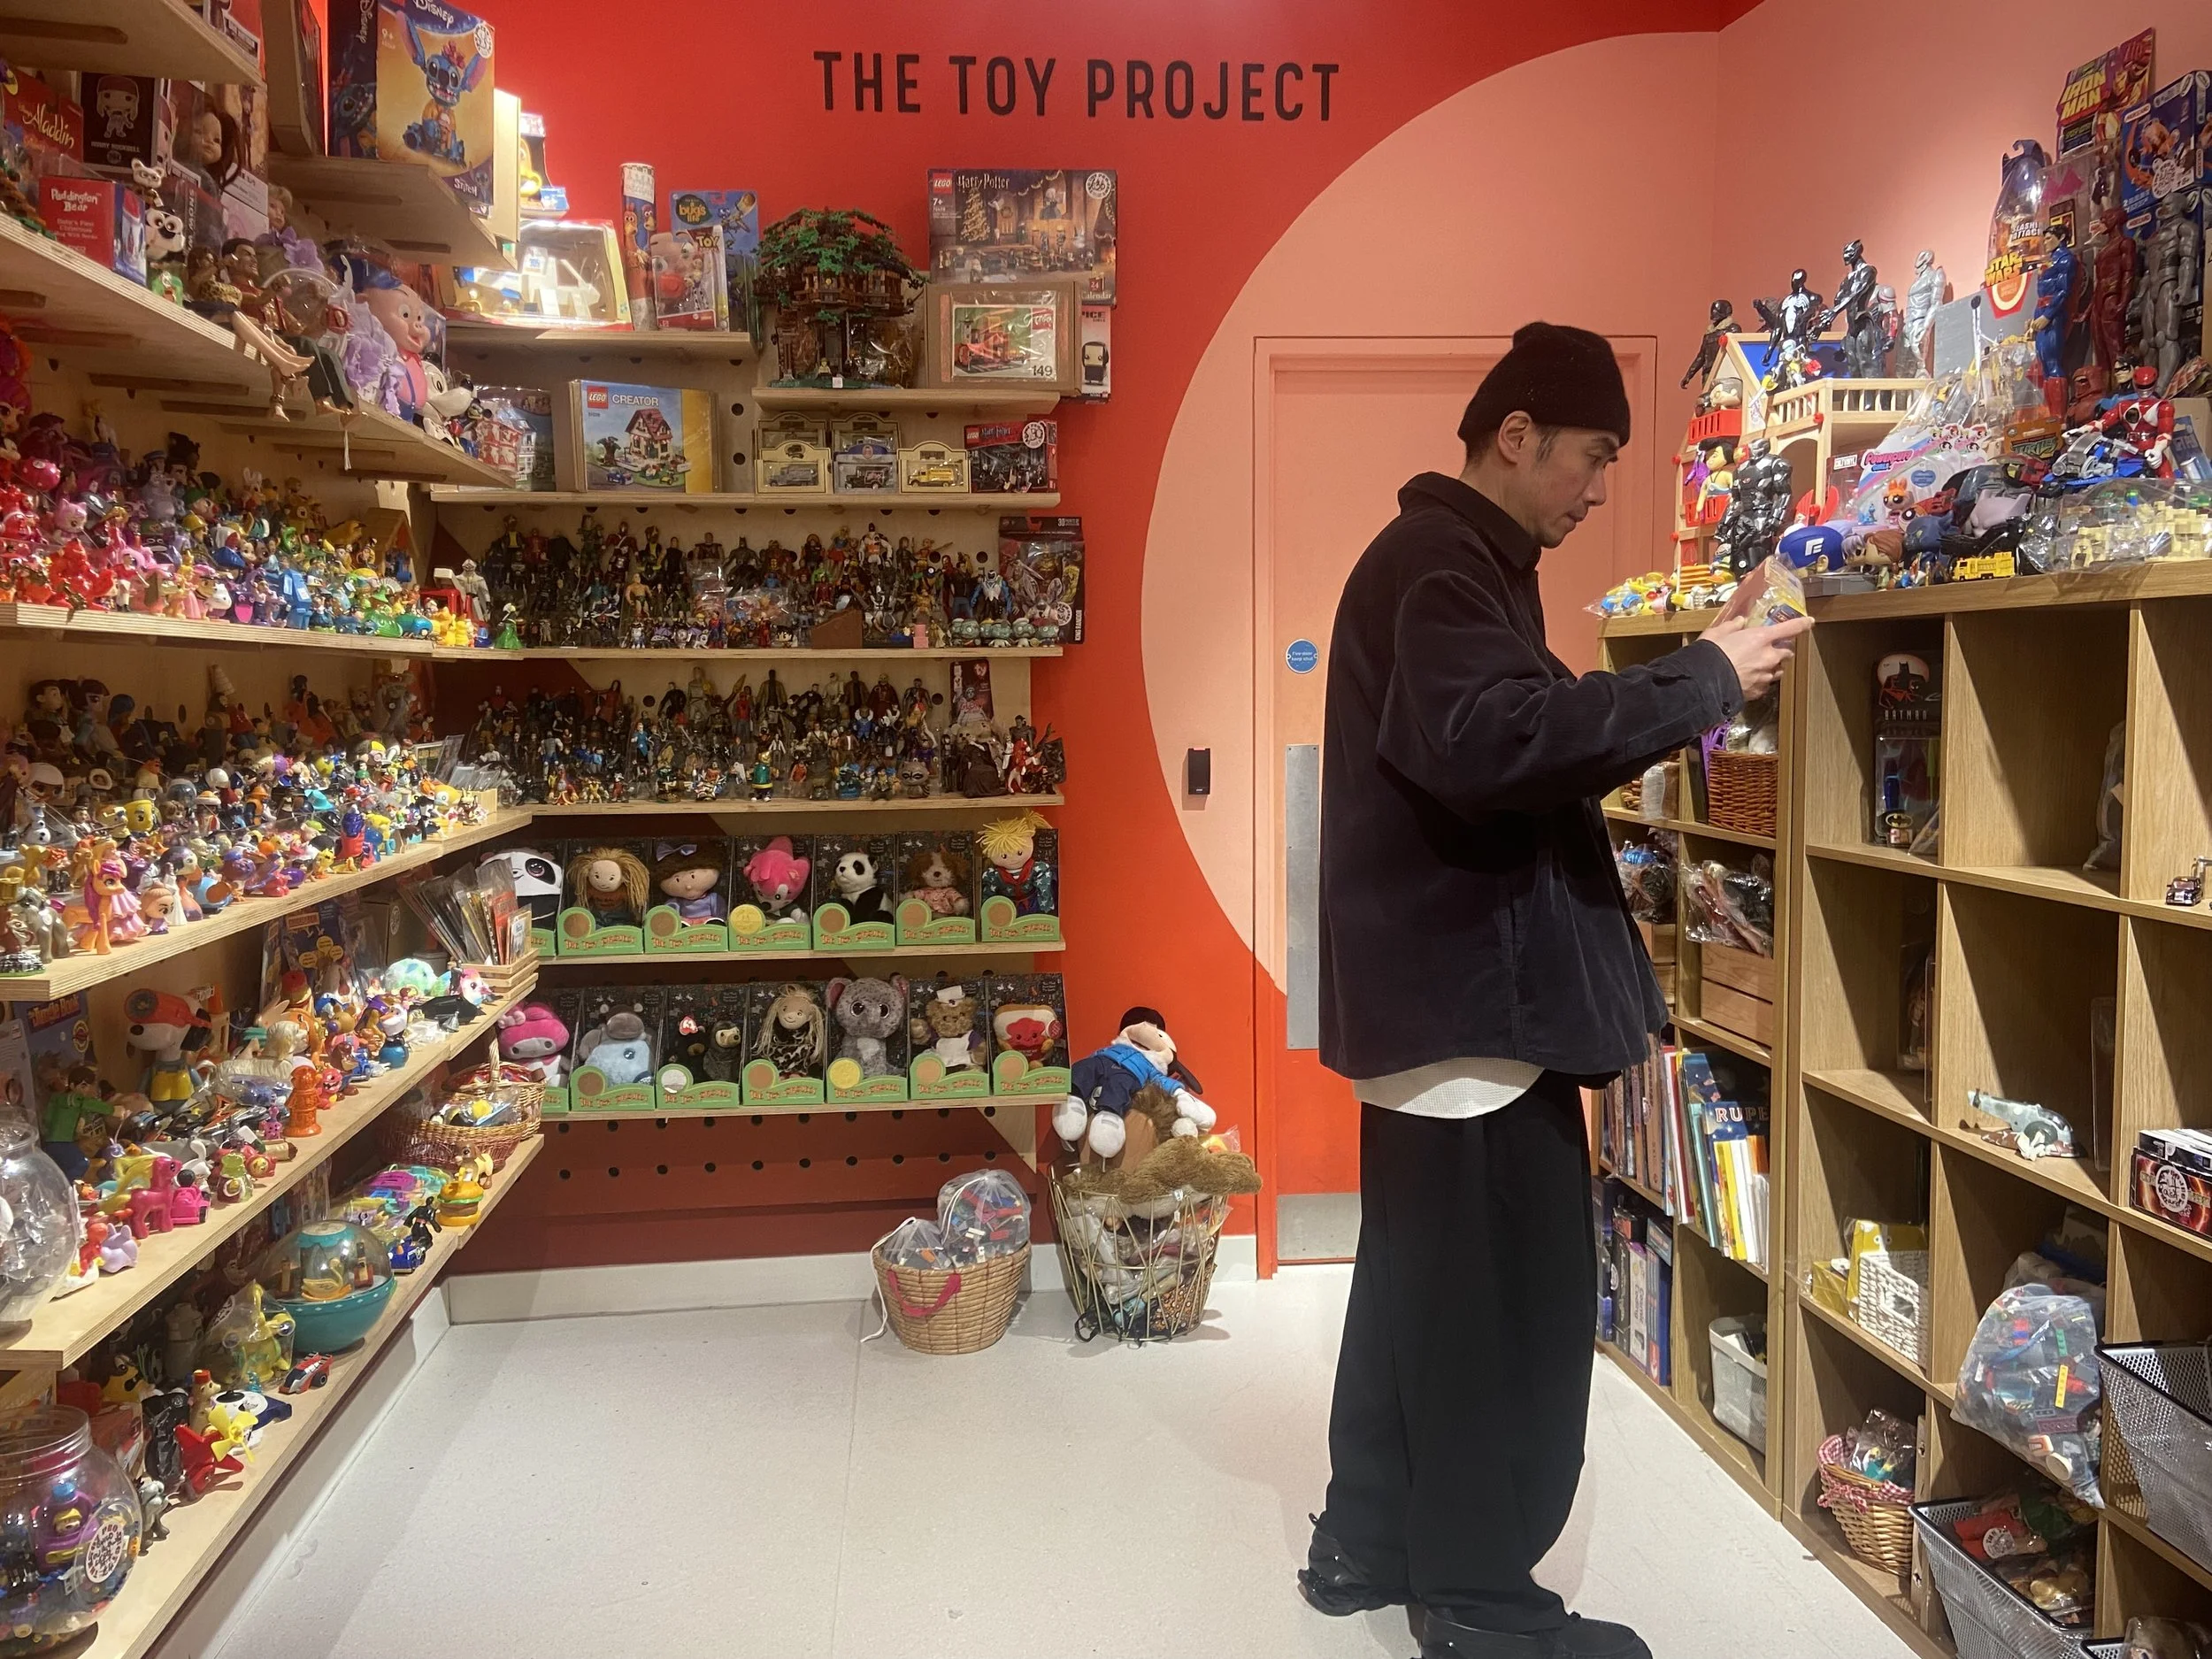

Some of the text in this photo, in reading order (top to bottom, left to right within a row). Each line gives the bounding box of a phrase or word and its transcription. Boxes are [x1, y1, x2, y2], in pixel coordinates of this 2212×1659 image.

[381, 28, 394, 40] 9+
[813, 51, 1339, 121] THE TOY PROJECT
[2062, 70, 2106, 104] IRON
[2062, 88, 2101, 119] MAN
[22, 104, 74, 149] Aladdin
[956, 173, 983, 192] Harry
[984, 173, 1010, 189] Potter
[51, 188, 97, 204] Paddington
[64, 201, 88, 211] Bear
[680, 204, 706, 218] bug's
[696, 235, 719, 249] TOY
[1986, 252, 2023, 273] STAR
[1985, 265, 2023, 287] WARS
[1032, 365, 1053, 377] 149
[612, 394, 658, 406] CREATOR
[1885, 710, 1927, 721] BATMAN
